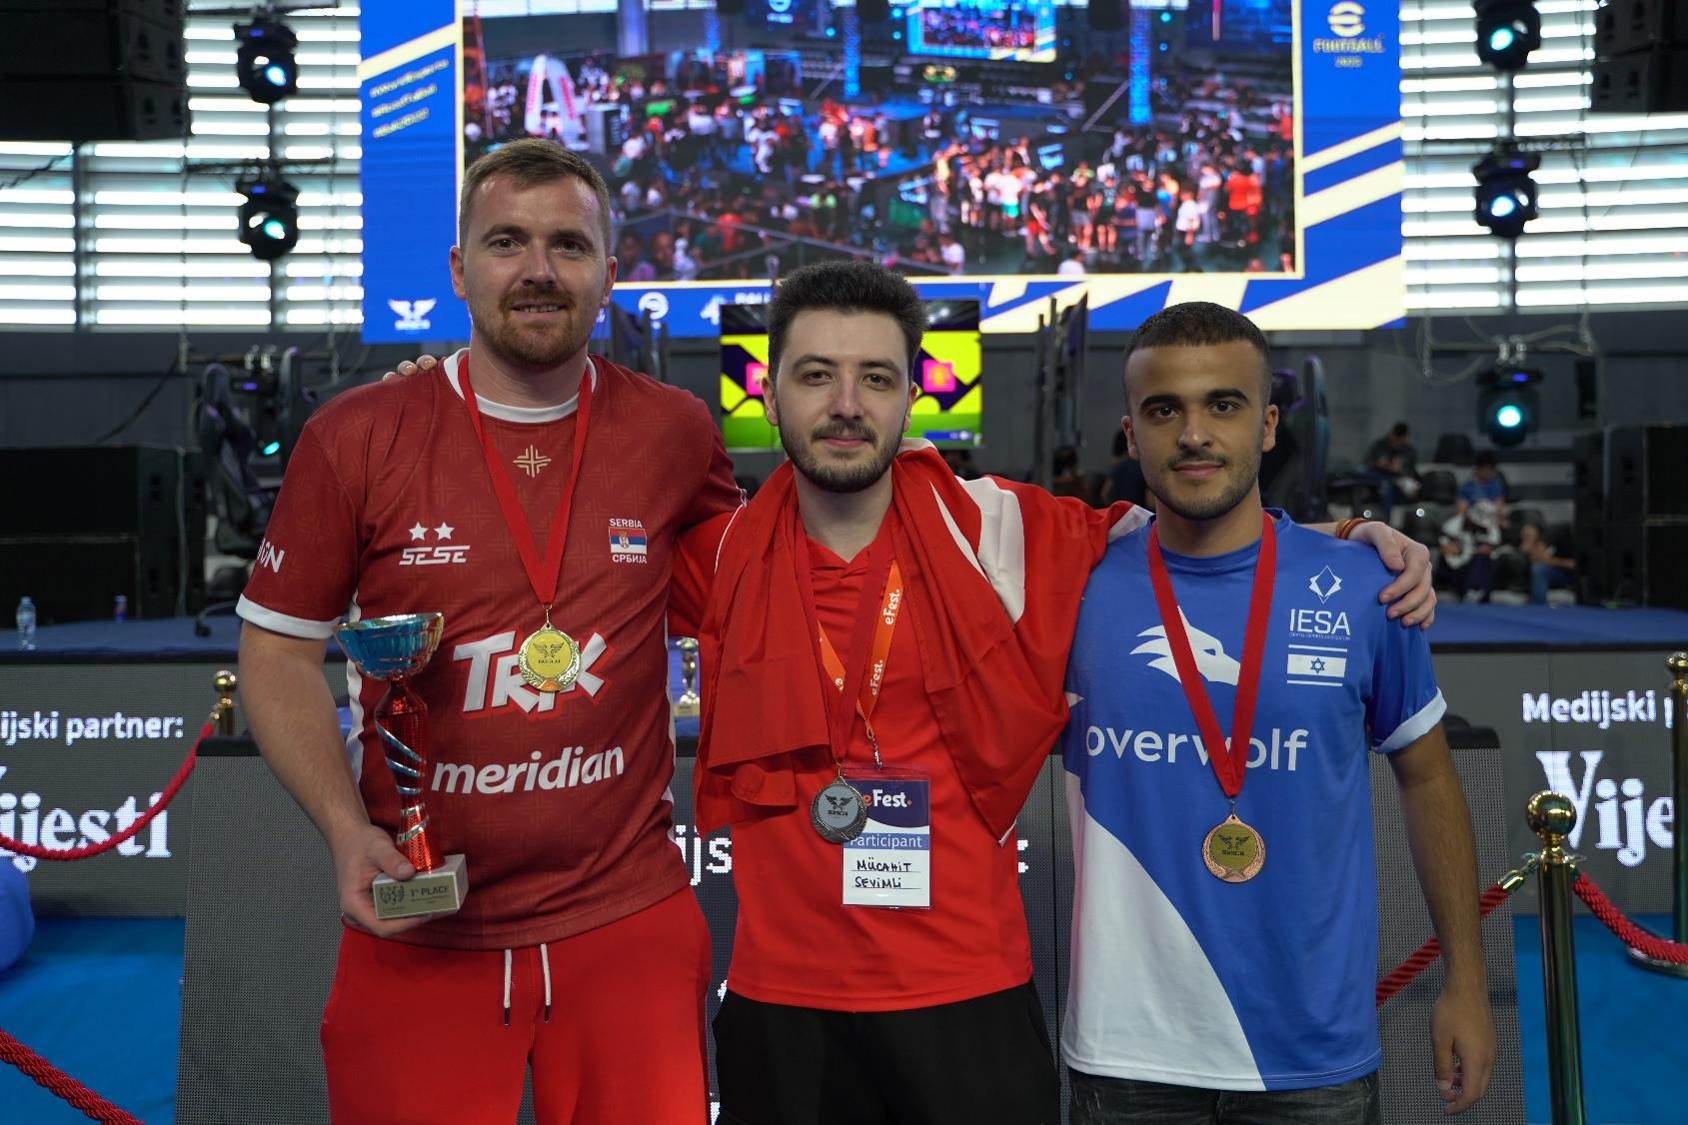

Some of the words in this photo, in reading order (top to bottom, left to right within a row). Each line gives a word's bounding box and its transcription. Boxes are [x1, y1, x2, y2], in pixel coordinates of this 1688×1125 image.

[609, 518, 643, 528] SERBIA
[612, 554, 648, 564] СРБИЈА
[883, 588, 901, 625] eFest.
[1289, 608, 1351, 635] IESA
[1522, 690, 1657, 729] Medijski
[66, 712, 184, 746] partner:
[431, 746, 625, 795] meridian
